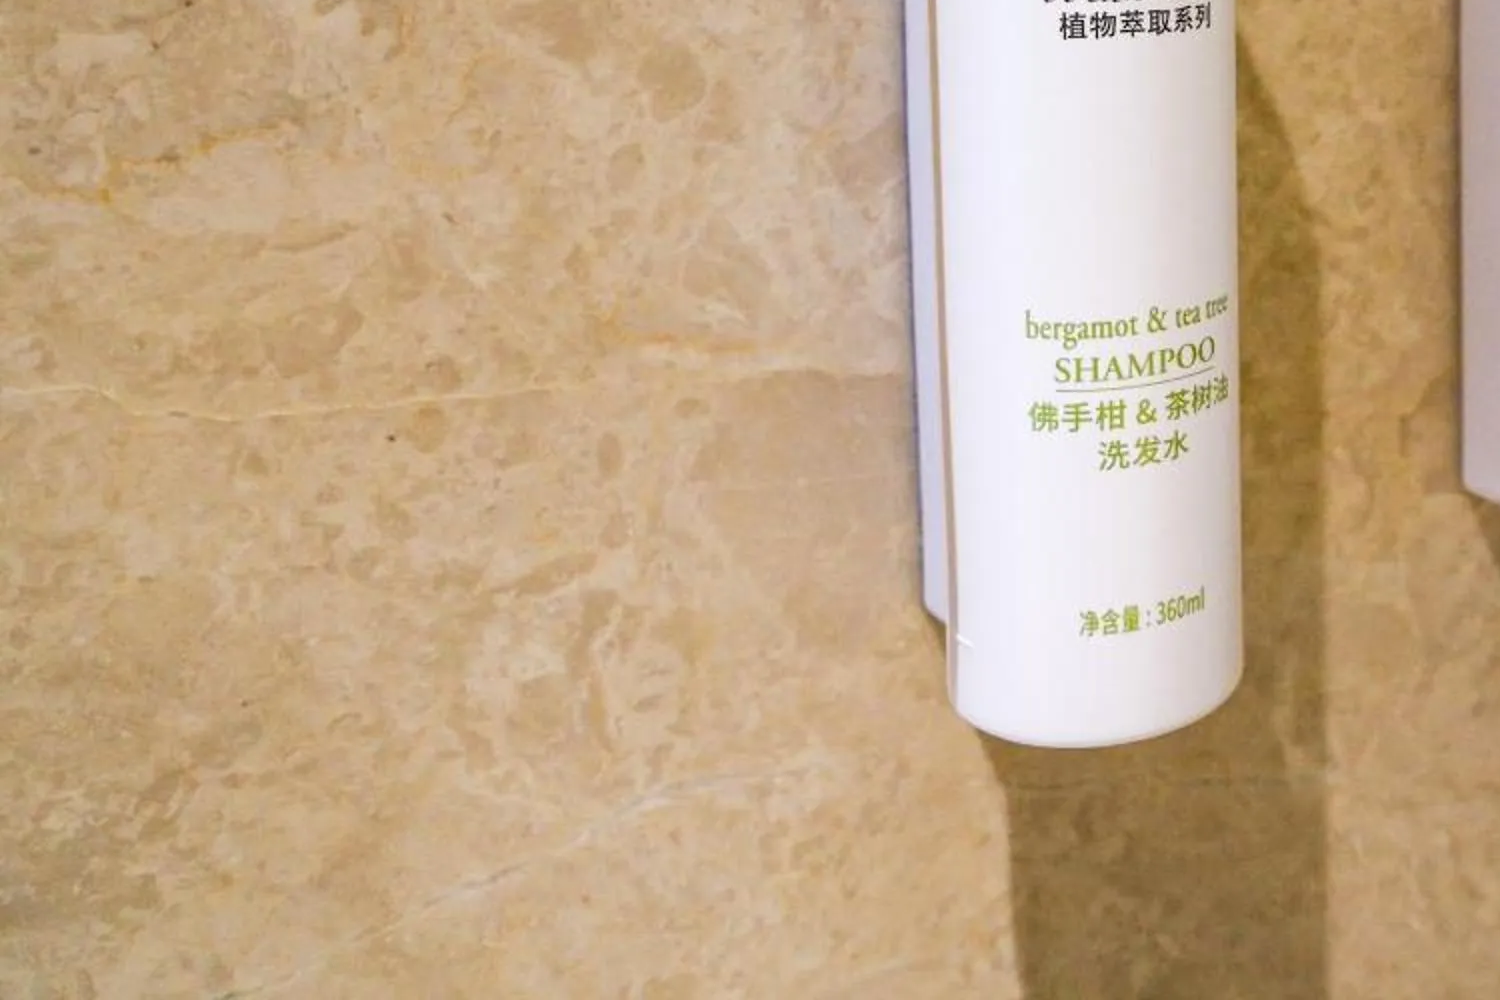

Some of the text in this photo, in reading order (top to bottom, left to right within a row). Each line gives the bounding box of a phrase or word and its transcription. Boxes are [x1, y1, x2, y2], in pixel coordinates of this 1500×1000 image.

[1058, 1, 1213, 41] 植物萃取系列
[1025, 309, 1138, 351] bergamot
[1146, 305, 1168, 333] &
[1175, 305, 1202, 329] tea
[1054, 335, 1216, 383] SHAMPOO
[1028, 401, 1128, 433] 佛手柑
[1135, 398, 1158, 425] &
[1098, 429, 1190, 472] 洗发水
